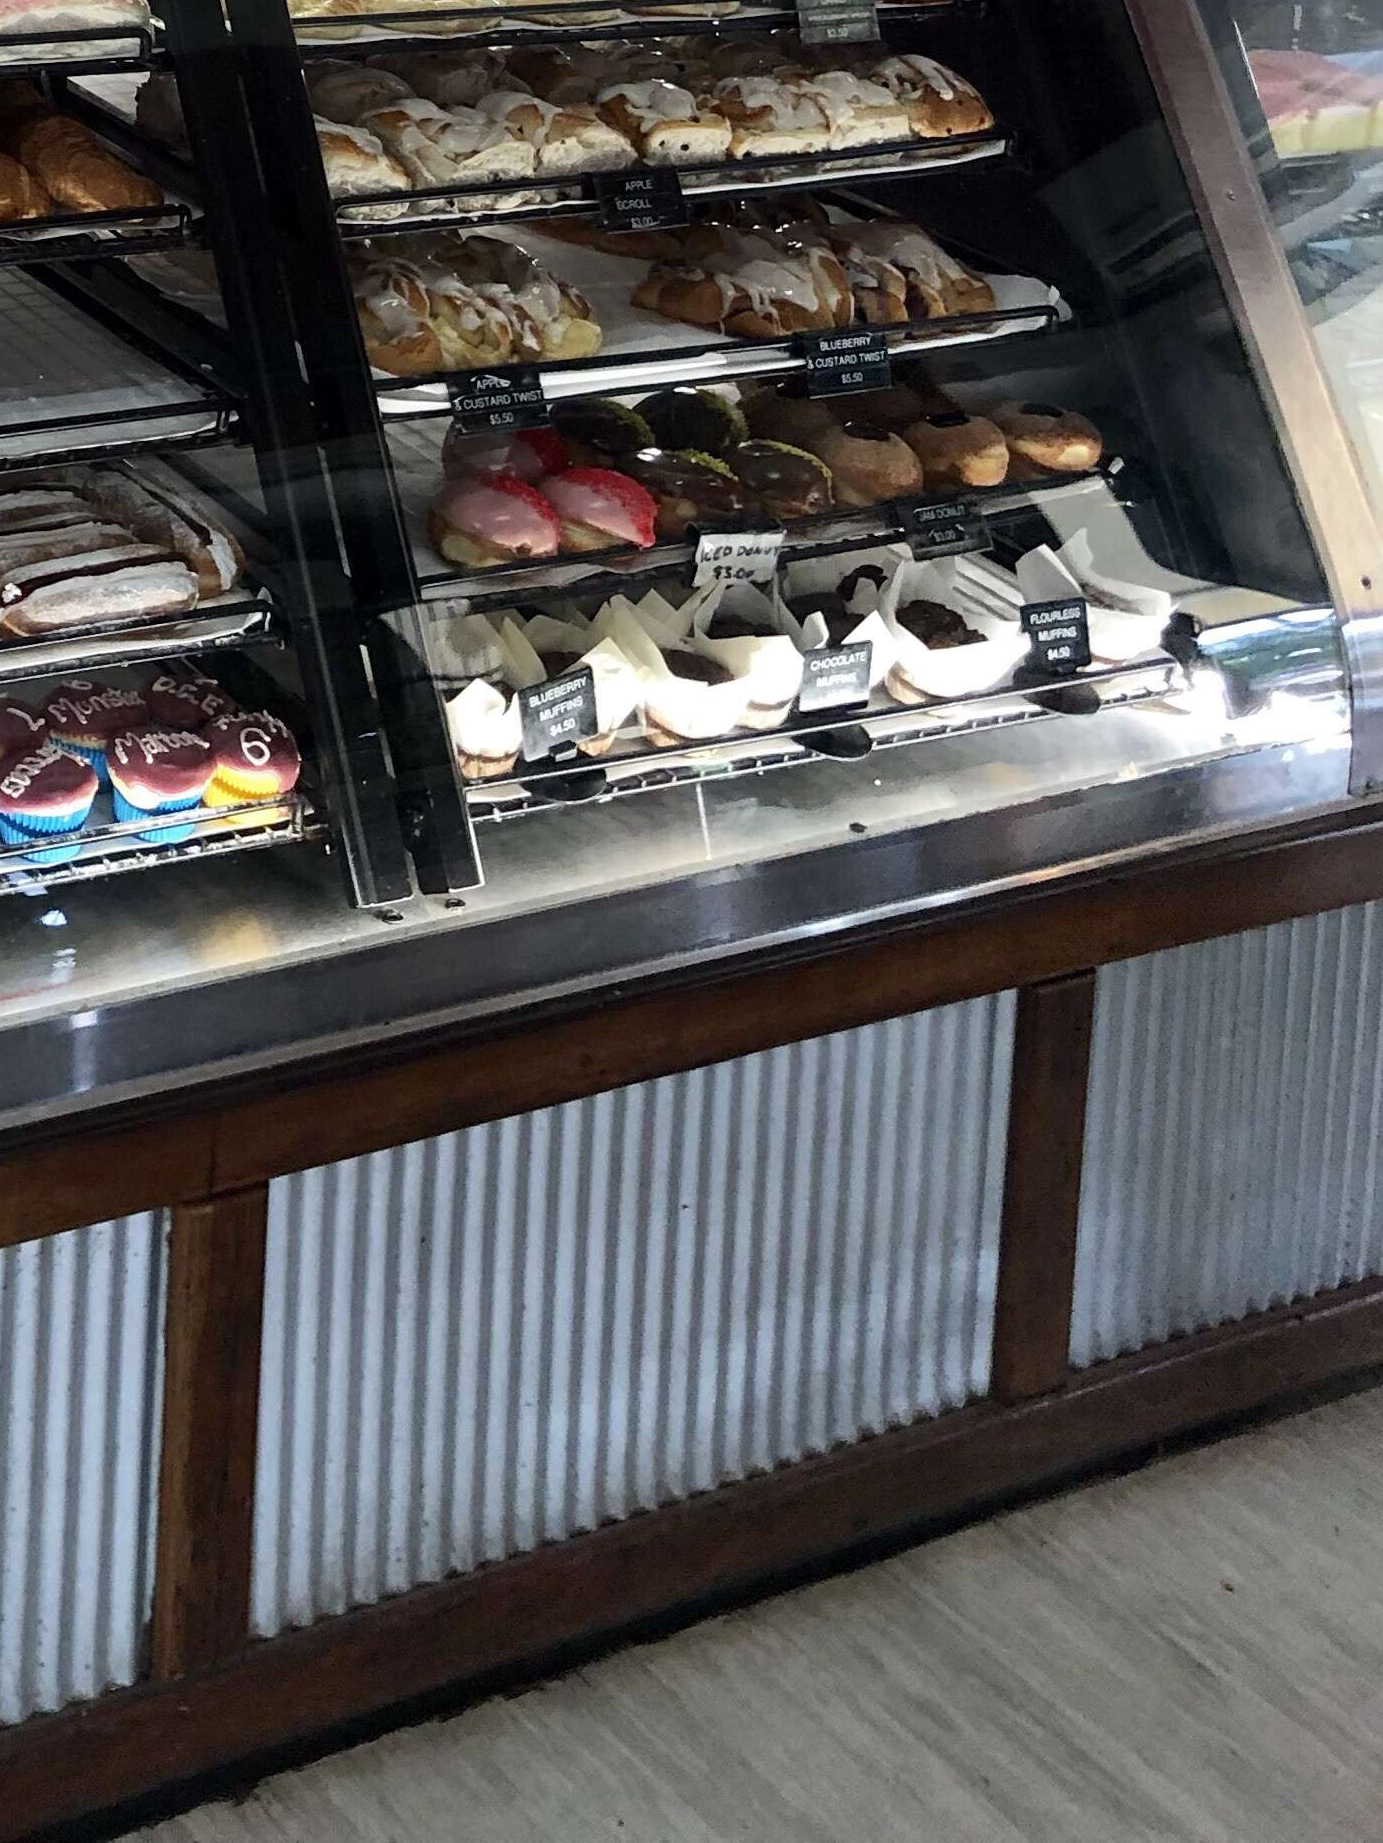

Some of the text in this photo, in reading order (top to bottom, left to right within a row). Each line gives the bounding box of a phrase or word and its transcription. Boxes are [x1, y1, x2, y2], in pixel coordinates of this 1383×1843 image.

[625, 179, 653, 192] APPLE
[819, 336, 872, 352] BLUEBERRY
[815, 354, 858, 369] CUSTARD
[858, 350, 886, 362] TWIST
[463, 395, 511, 410] CUSTARD
[512, 389, 542, 403] TWIST
[489, 412, 514, 426] $5.50
[810, 651, 867, 671] CHOCOLATE
[529, 676, 587, 709] BLUEBERRY
